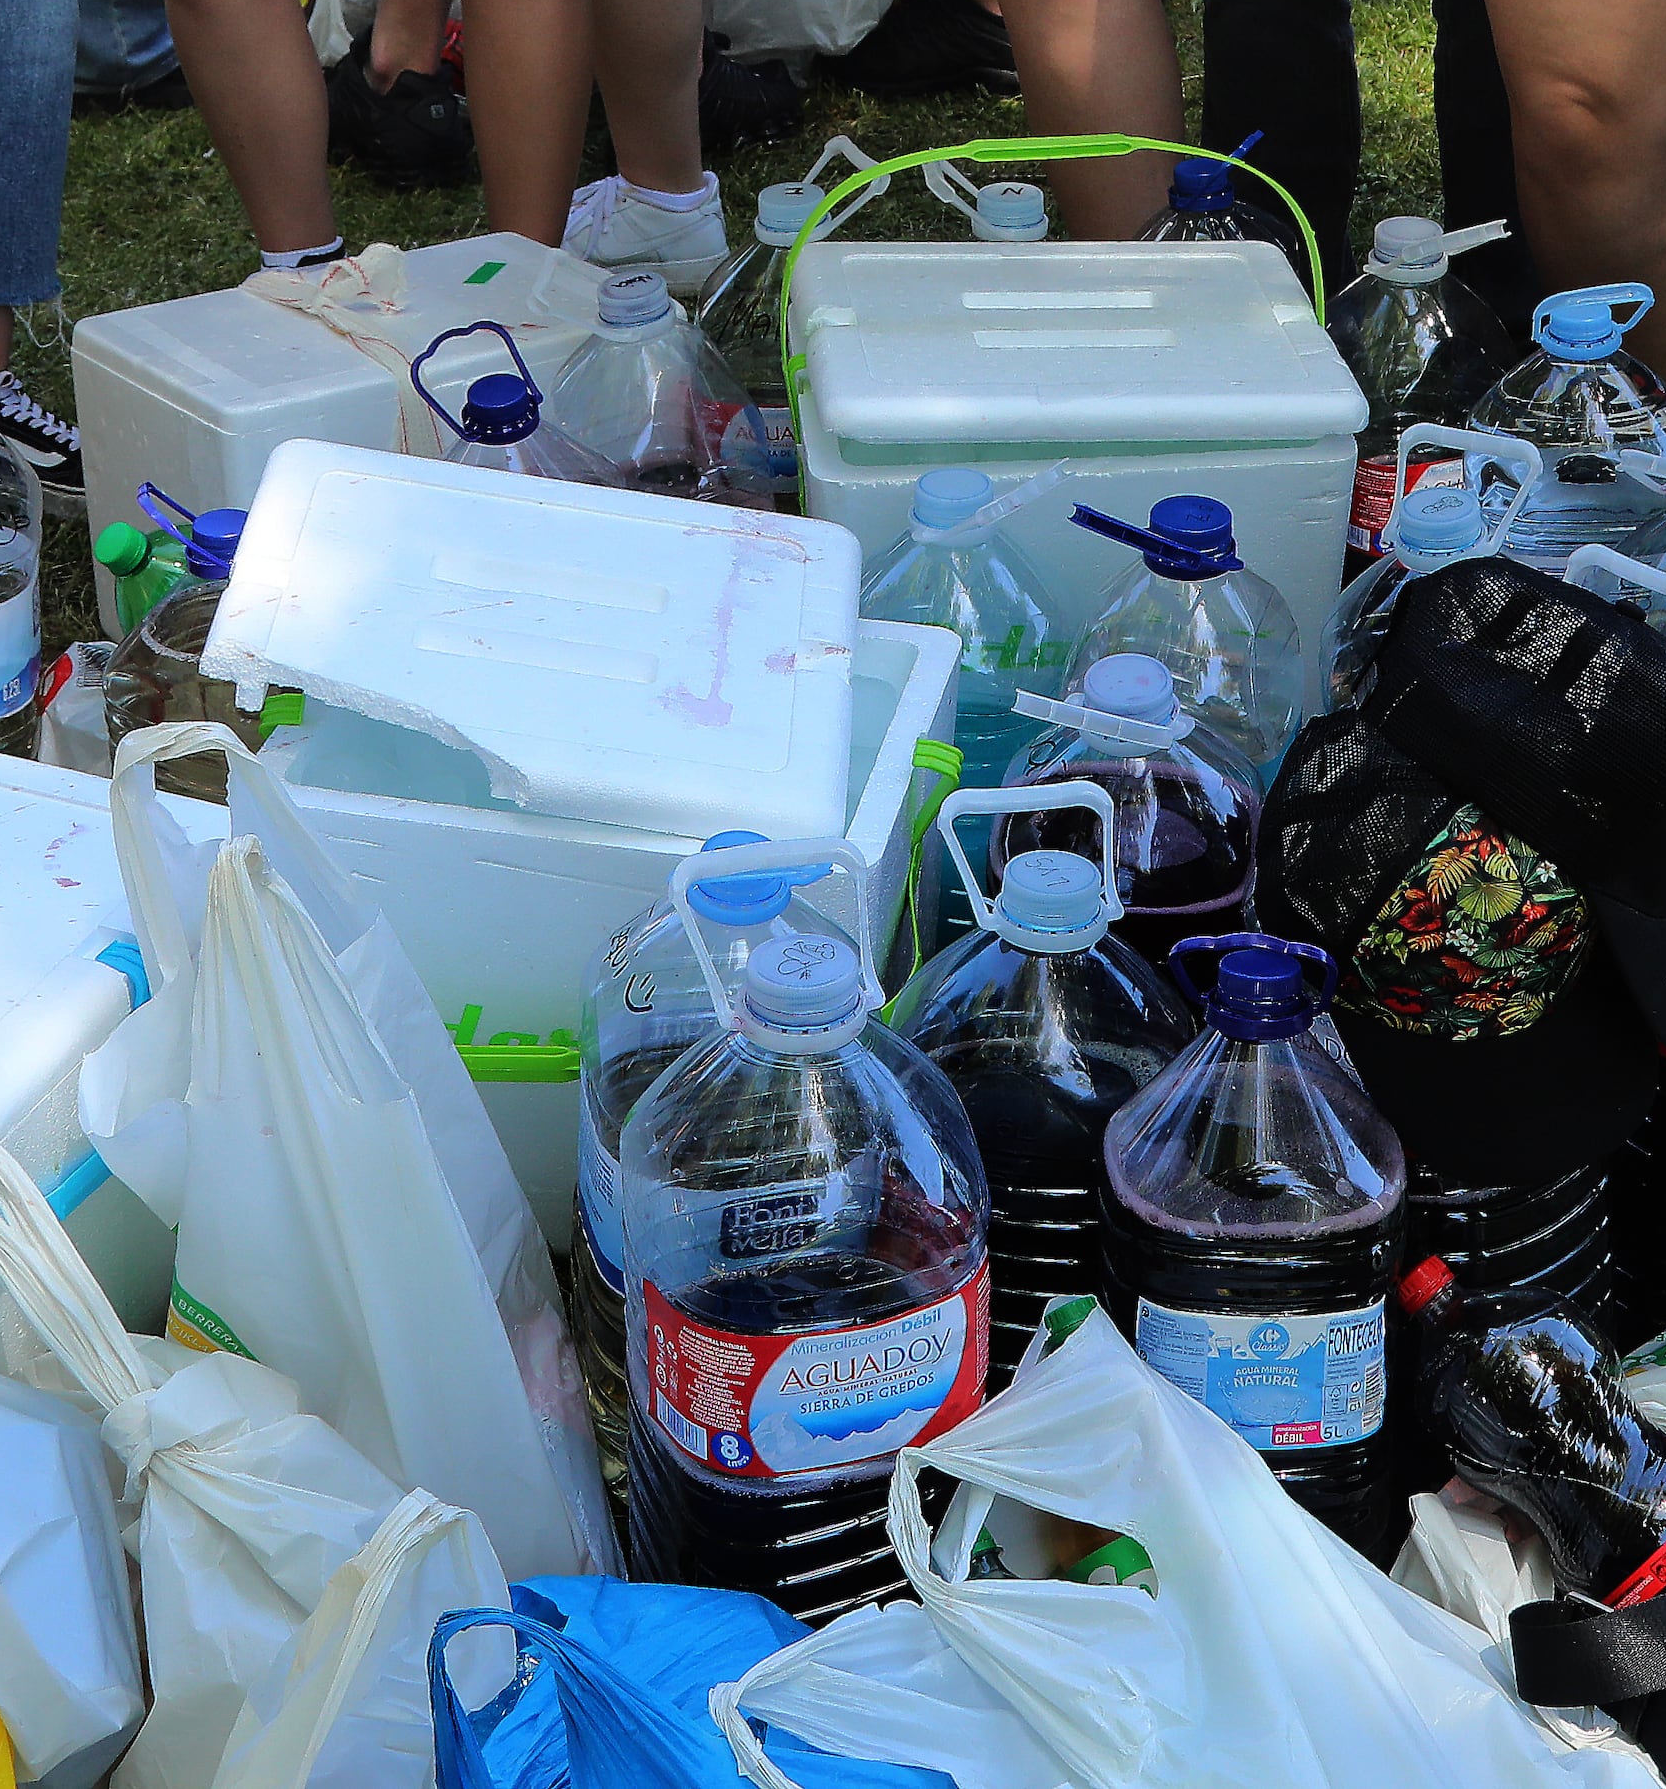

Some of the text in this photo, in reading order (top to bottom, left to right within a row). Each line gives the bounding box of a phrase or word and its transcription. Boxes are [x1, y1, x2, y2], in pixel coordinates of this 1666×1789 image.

[735, 1194, 815, 1225] Font
[790, 1308, 943, 1357] Mineralización Débil
[779, 1326, 954, 1394] AGUADOY
[1235, 1365, 1301, 1377] AGUA MINERAL
[800, 1371, 935, 1416] SIERRA DE GREDOS
[817, 1367, 919, 1398] AGUA MINERAL NATURAL
[1233, 1374, 1299, 1388] NATURAL
[719, 1433, 740, 1461] 8
[1274, 1431, 1306, 1445] DÉBIL
